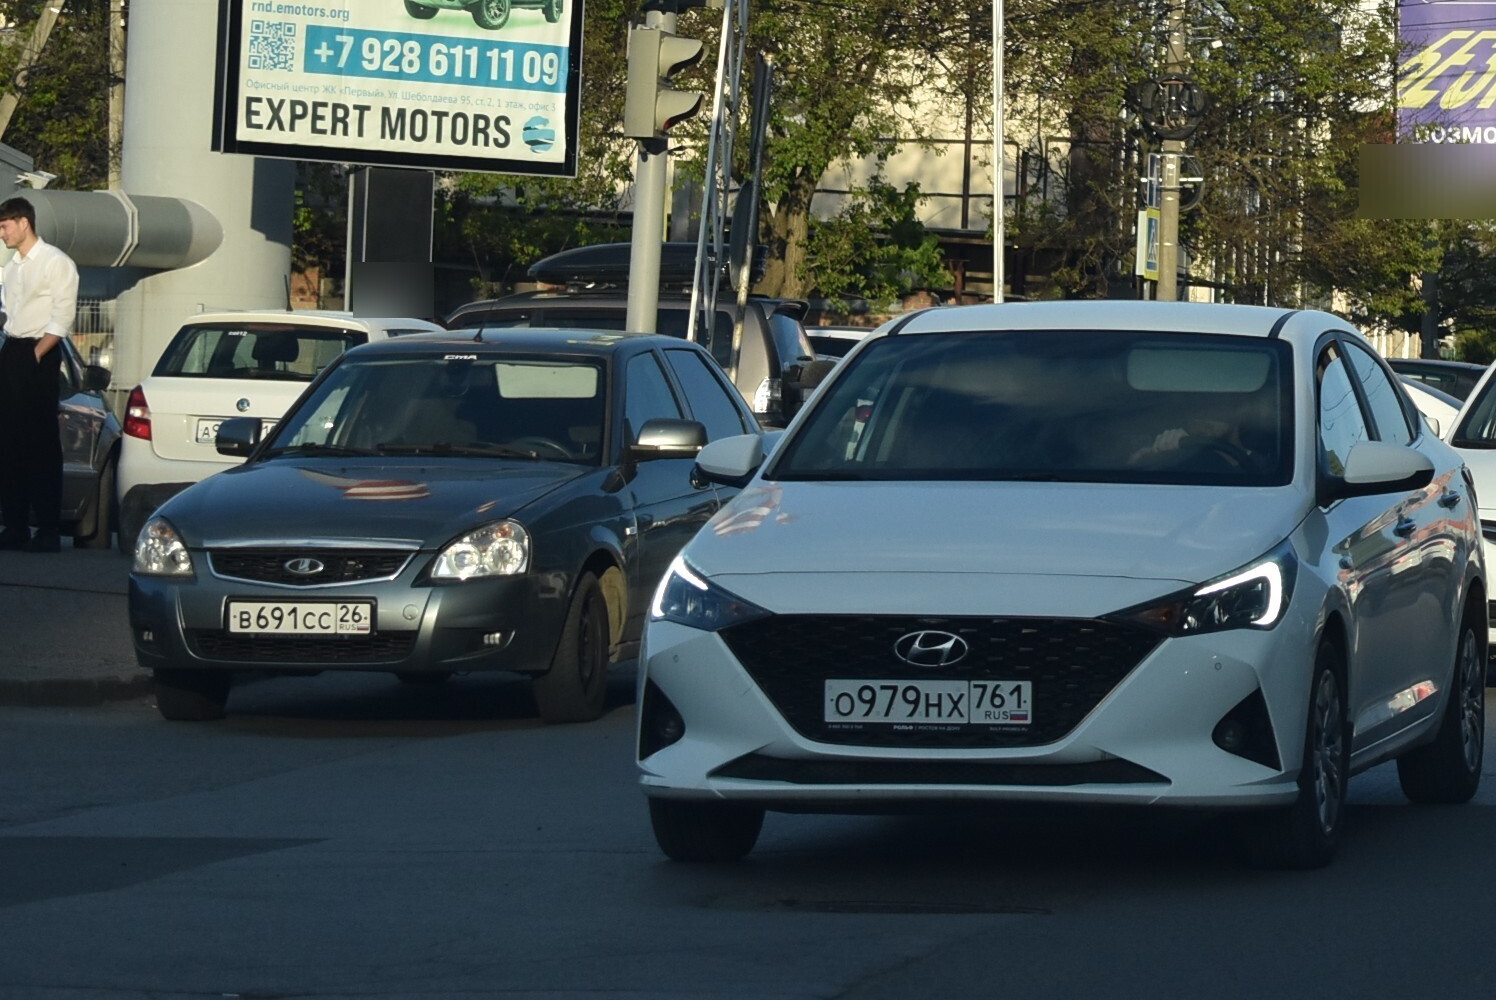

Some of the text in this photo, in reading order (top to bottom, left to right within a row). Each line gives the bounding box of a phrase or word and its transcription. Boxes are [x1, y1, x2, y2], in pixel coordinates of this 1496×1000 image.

[251, 0, 350, 22] rnd.emotors.org
[313, 34, 559, 86] +7 928 611 11 09
[246, 78, 289, 90] Офисный
[292, 83, 319, 94] центр
[245, 96, 512, 149] EXPERT MOTORS
[339, 605, 362, 623] 26
[339, 623, 357, 631] RUS
[972, 684, 1023, 709] 761
[984, 710, 1009, 720] RUS
